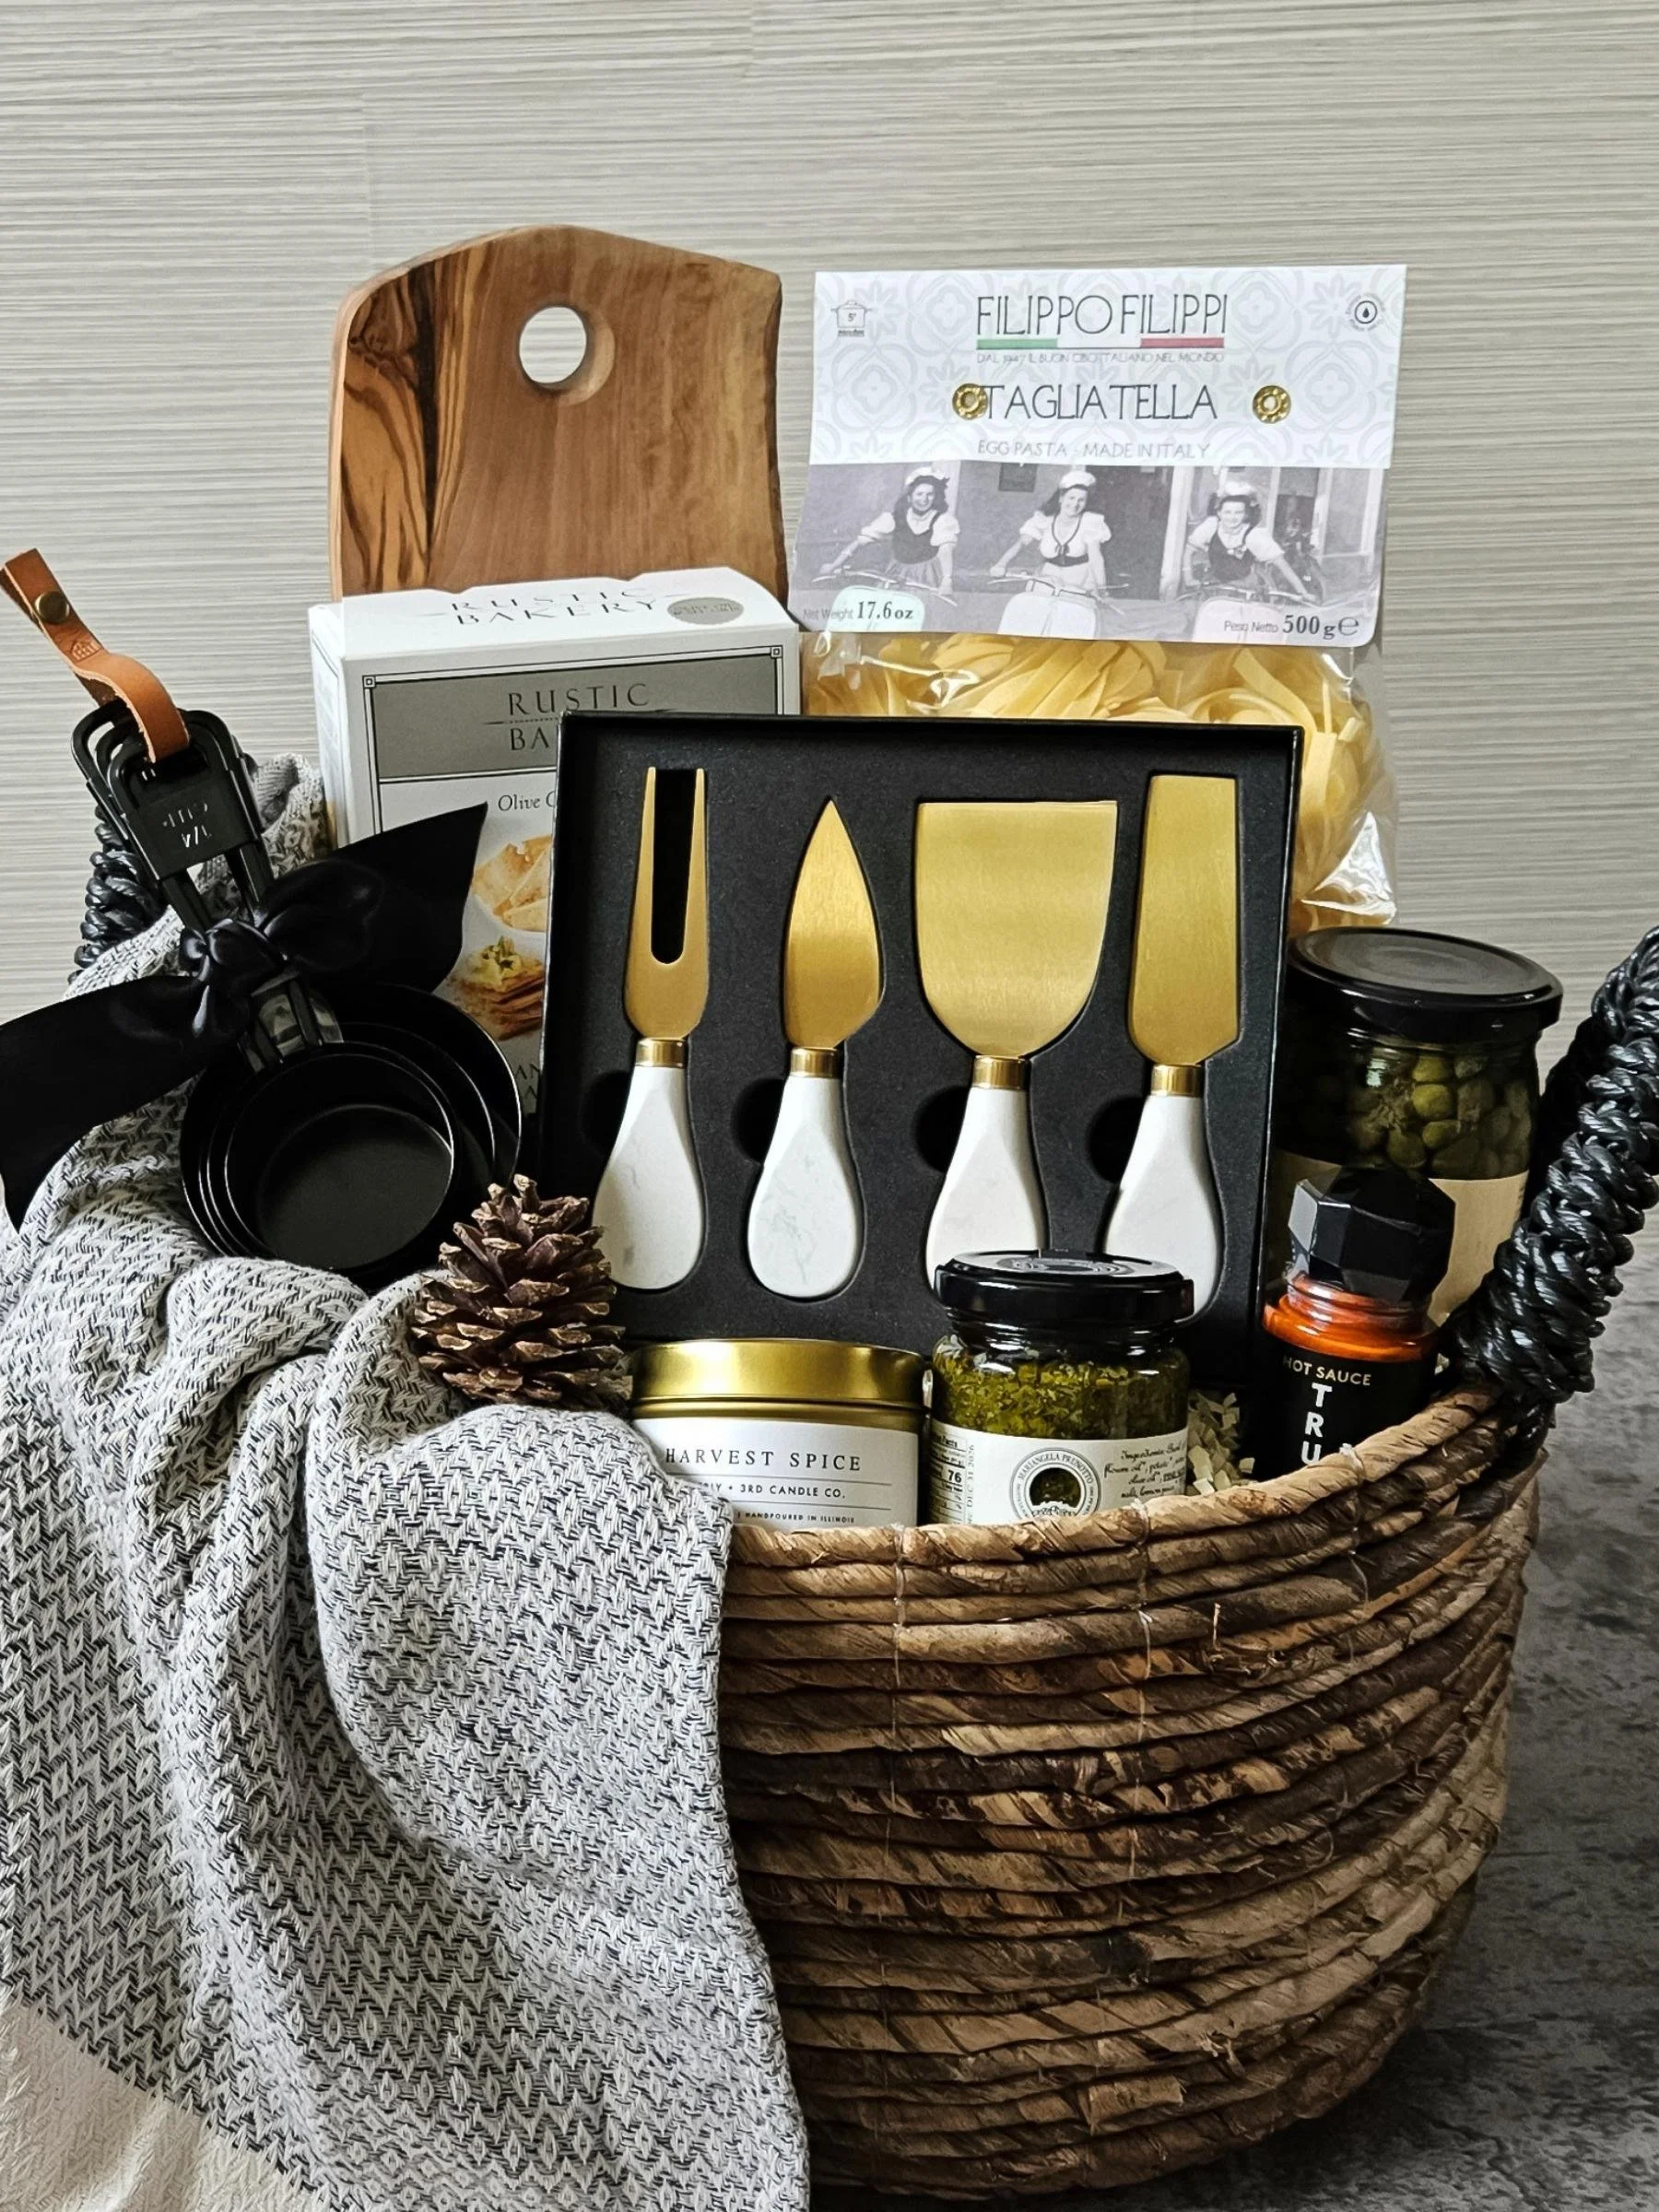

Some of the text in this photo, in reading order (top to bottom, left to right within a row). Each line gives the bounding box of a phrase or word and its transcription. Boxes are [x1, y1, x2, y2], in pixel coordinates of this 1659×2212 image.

[977, 293, 1228, 335] FILIPPO FILIPPI
[980, 383, 1218, 419] TAGLIATELLA
[978, 440, 1010, 455] EGG
[1014, 441, 1068, 457] PASTA
[1083, 441, 1133, 458] MADE
[1137, 441, 1152, 458] IN
[1156, 441, 1212, 458] ITALY
[457, 597, 657, 625] BAKERY
[1251, 620, 1279, 633] Netto
[508, 683, 649, 716] RUSTIC
[498, 794, 541, 812] Olive
[1282, 1353, 1372, 1386] HOT SAUCE
[665, 1447, 862, 1472] HARVEST SPICE
[740, 1483, 847, 1500] 3RD CANDLE CO.
[745, 1512, 804, 1521] HANDPOURED
[819, 1515, 855, 1524] ILLINOIS
